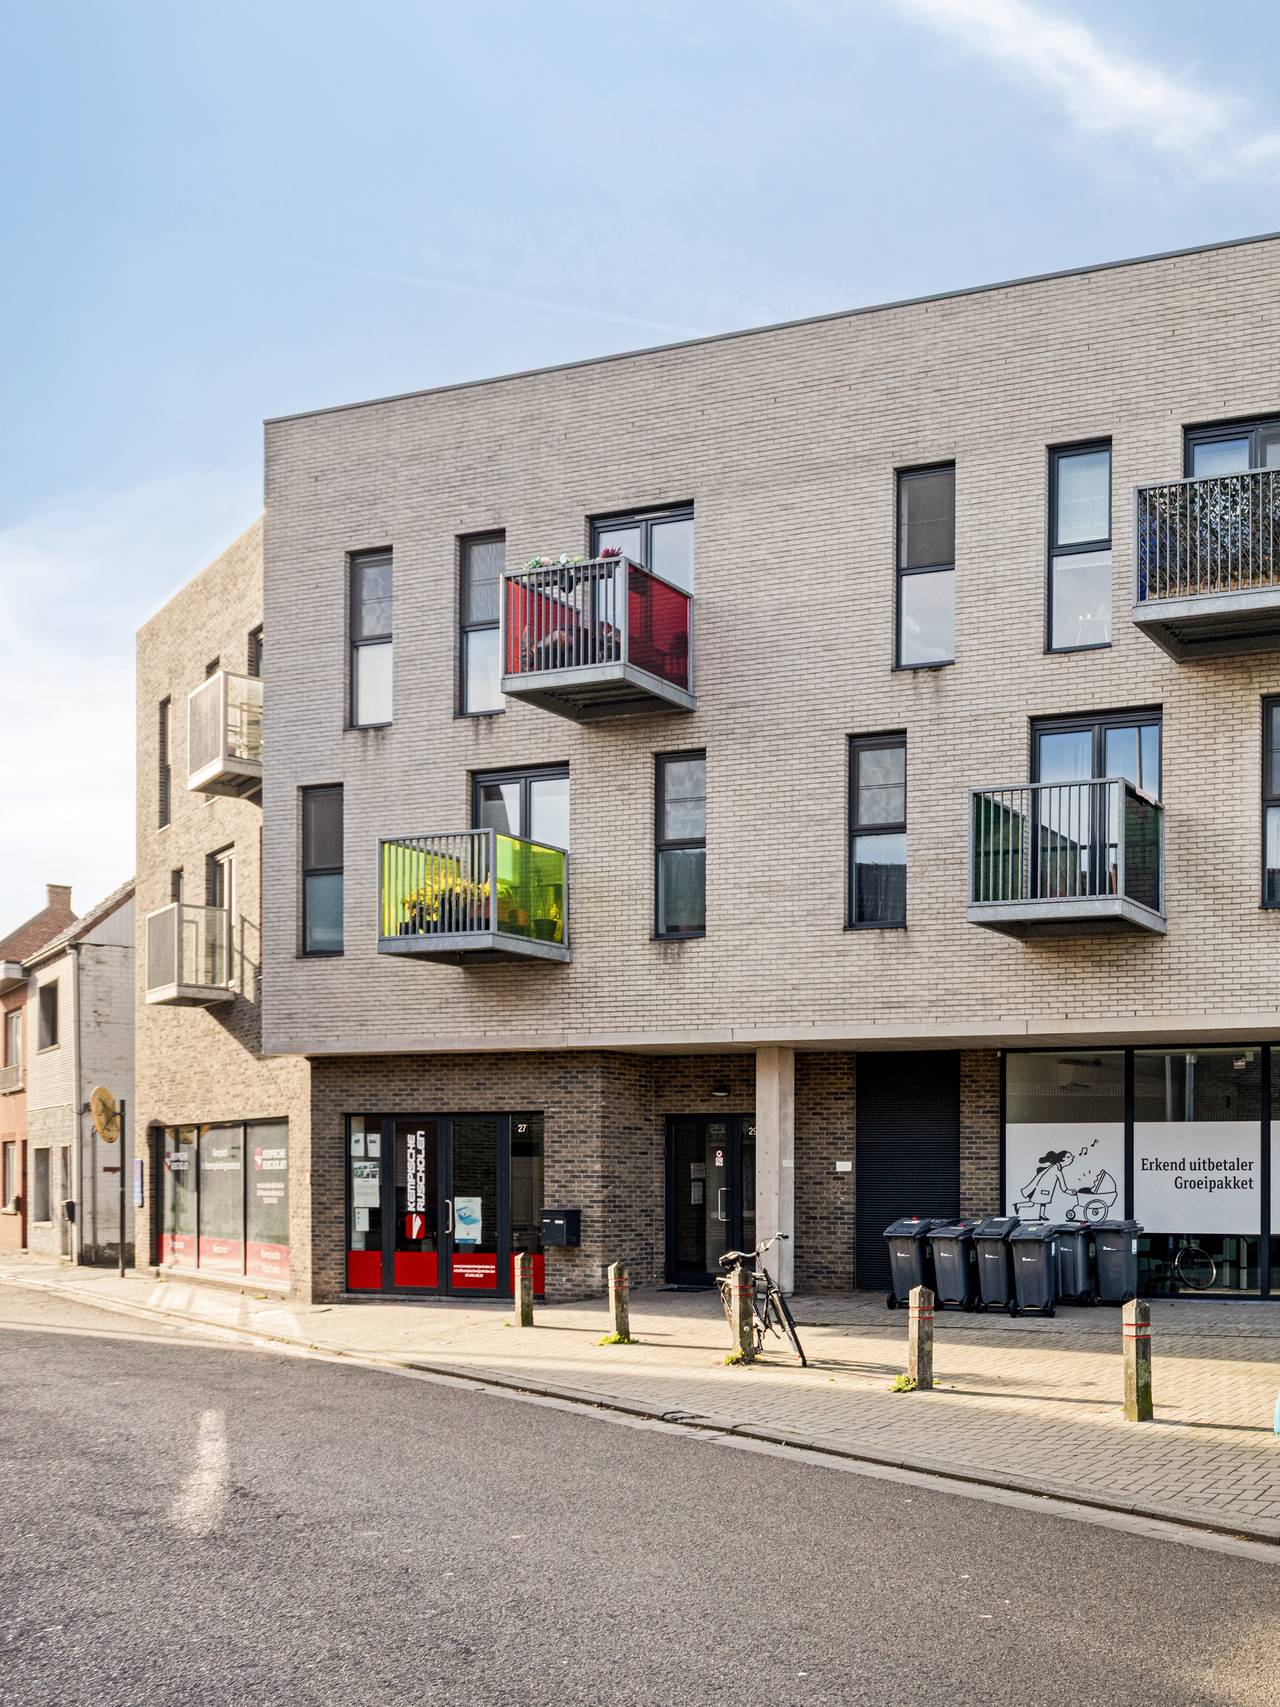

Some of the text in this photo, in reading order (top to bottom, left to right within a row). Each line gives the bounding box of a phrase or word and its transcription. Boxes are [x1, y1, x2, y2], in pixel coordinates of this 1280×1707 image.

[517, 1124, 527, 1133] 27
[1141, 1158, 1254, 1171] Erkend uitbetaler
[1174, 1176, 1254, 1192] Groeipakket
